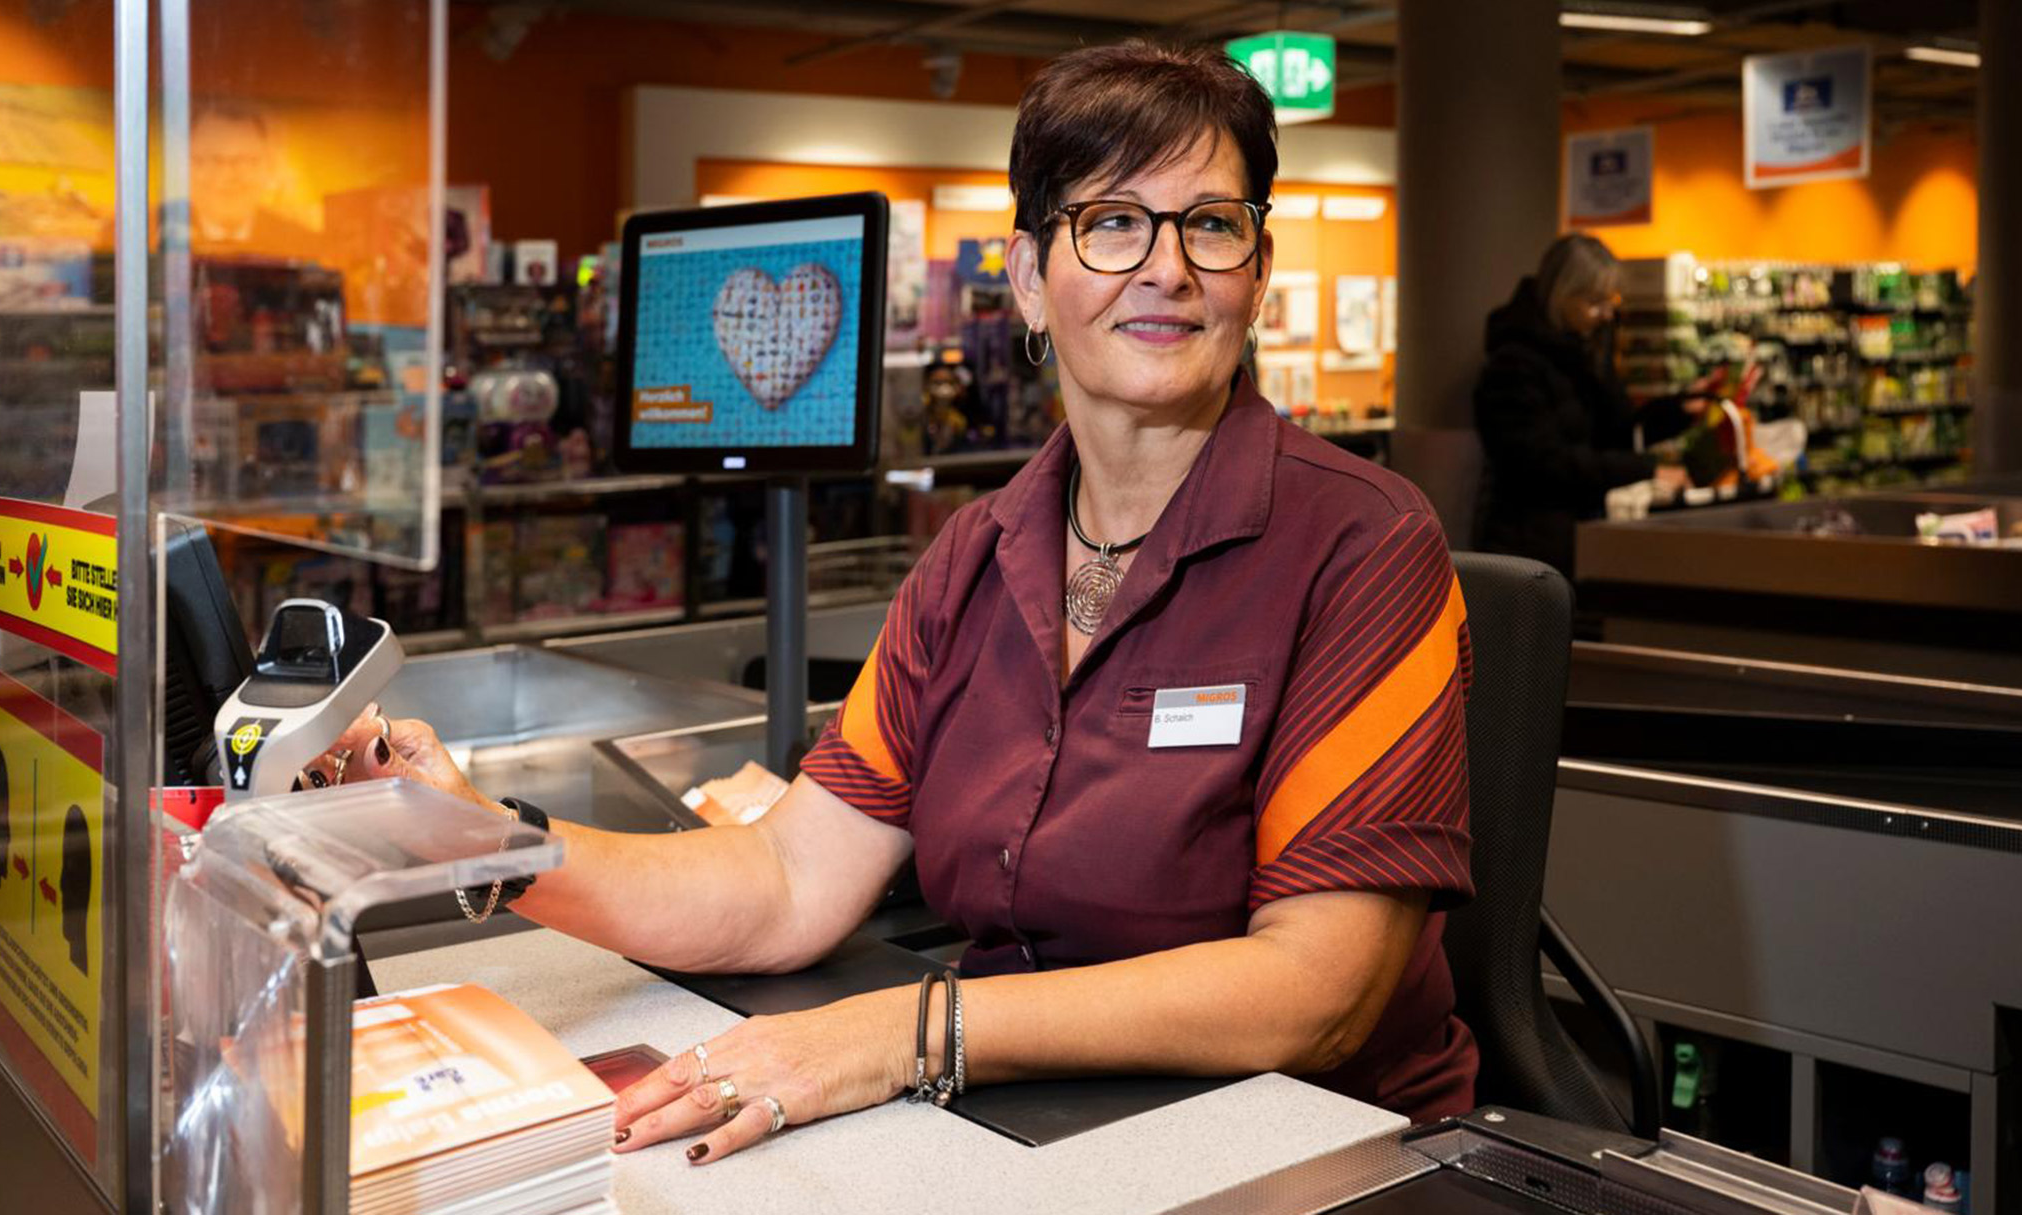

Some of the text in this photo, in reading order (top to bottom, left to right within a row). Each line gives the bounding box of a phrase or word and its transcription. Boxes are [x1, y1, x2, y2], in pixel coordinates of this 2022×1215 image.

[71, 559, 90, 583] BITTE
[66, 585, 77, 607] SIE
[78, 590, 94, 613] SICH
[96, 595, 112, 621] HIER
[1196, 692, 1237, 703] MIGROS
